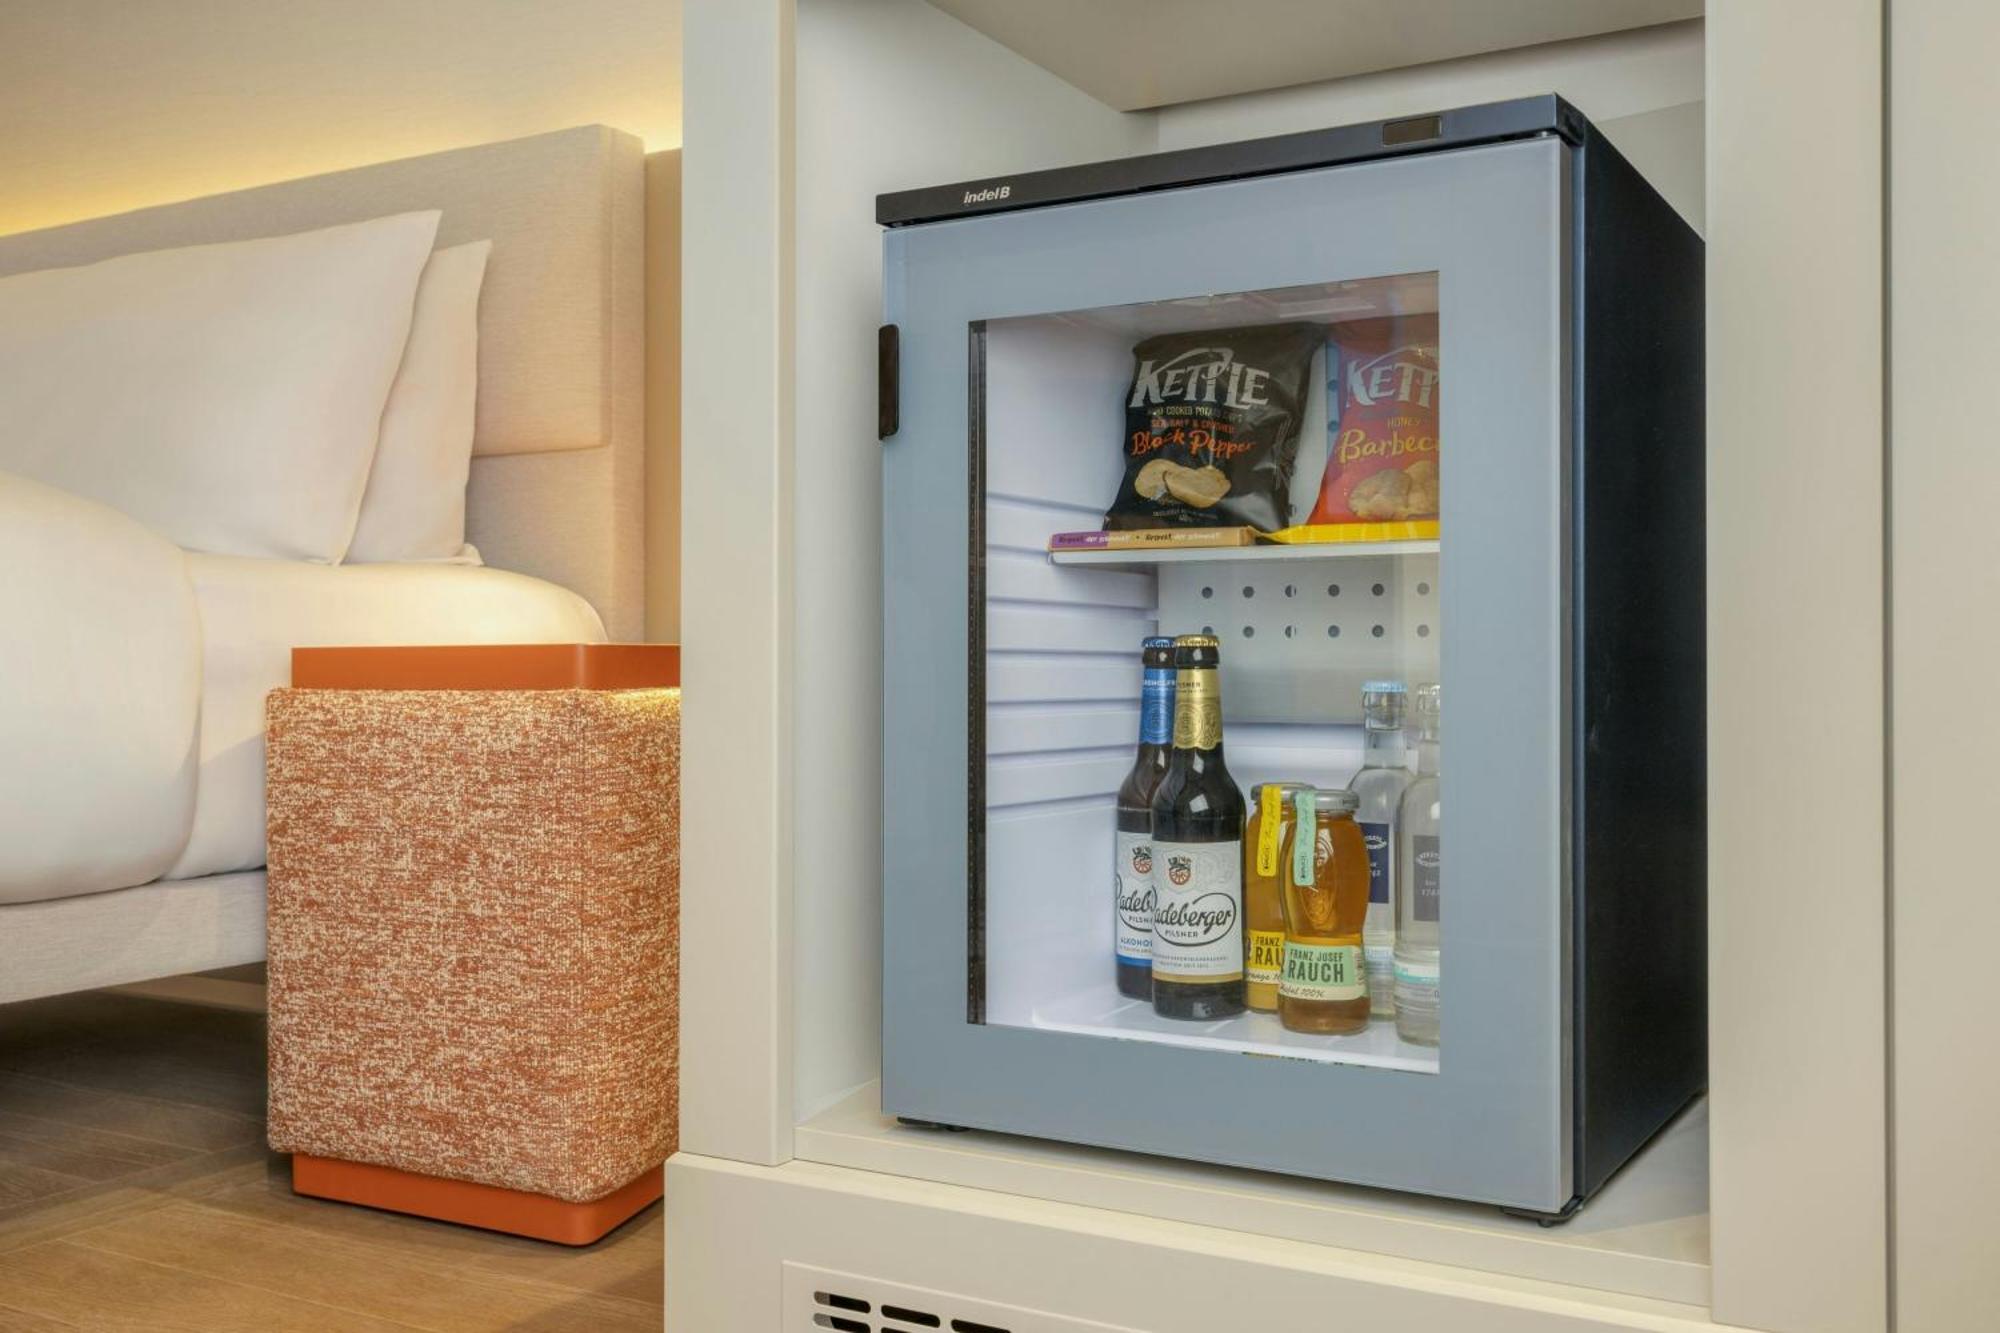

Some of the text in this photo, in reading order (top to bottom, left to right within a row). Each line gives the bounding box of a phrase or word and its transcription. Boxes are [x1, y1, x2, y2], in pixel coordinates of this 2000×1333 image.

[1128, 347, 1270, 410] KETTLE
[1344, 347, 1439, 409] KETT
[1130, 429, 1257, 459] Black Pepper
[1337, 428, 1439, 464] Barbec
[1164, 929, 1198, 938] PILSNER
[1255, 935, 1281, 947] FRANZ
[1289, 948, 1345, 962] FRANZ JOSEF
[1287, 959, 1344, 983] RAUCH
